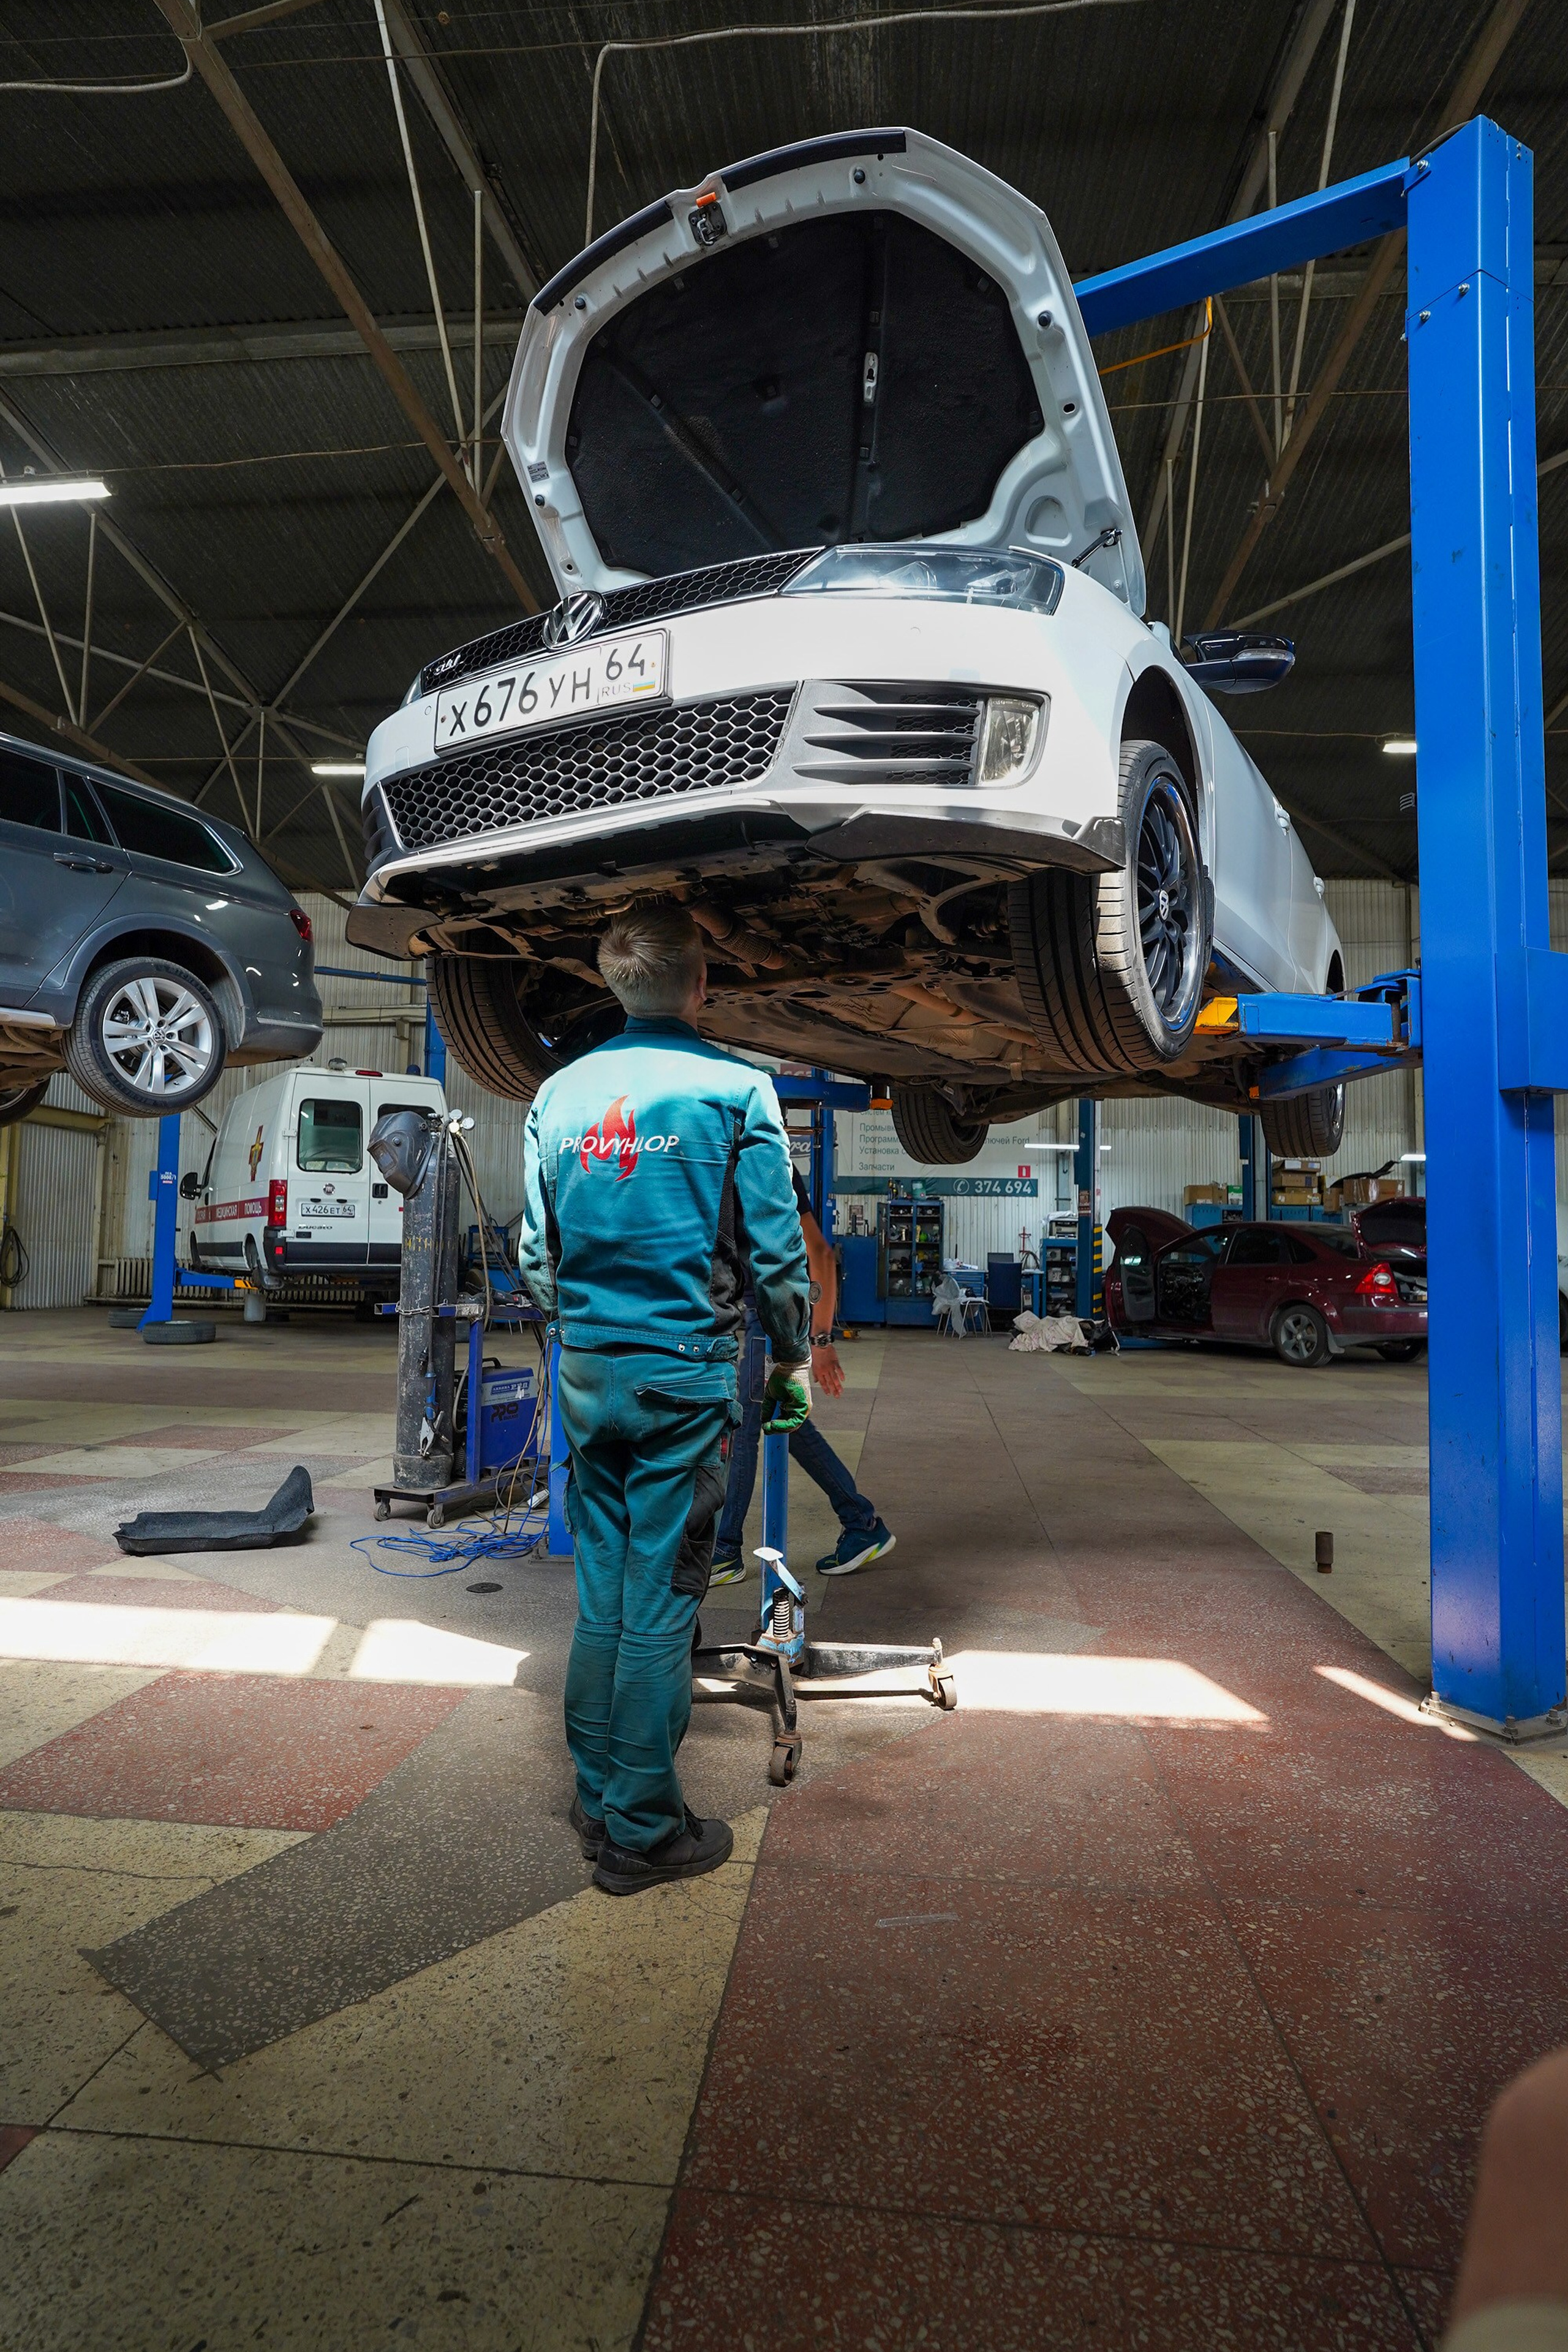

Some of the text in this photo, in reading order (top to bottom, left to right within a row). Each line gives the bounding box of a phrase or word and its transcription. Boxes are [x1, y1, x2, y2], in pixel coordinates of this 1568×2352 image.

[606, 643, 645, 681] 64
[601, 682, 631, 697] RUS
[860, 1123, 895, 1132] Промывк
[859, 1134, 899, 1144] Программ
[859, 1146, 899, 1155] Установка
[859, 1162, 895, 1171] Запчасти
[974, 1180, 1031, 1194] 374 694
